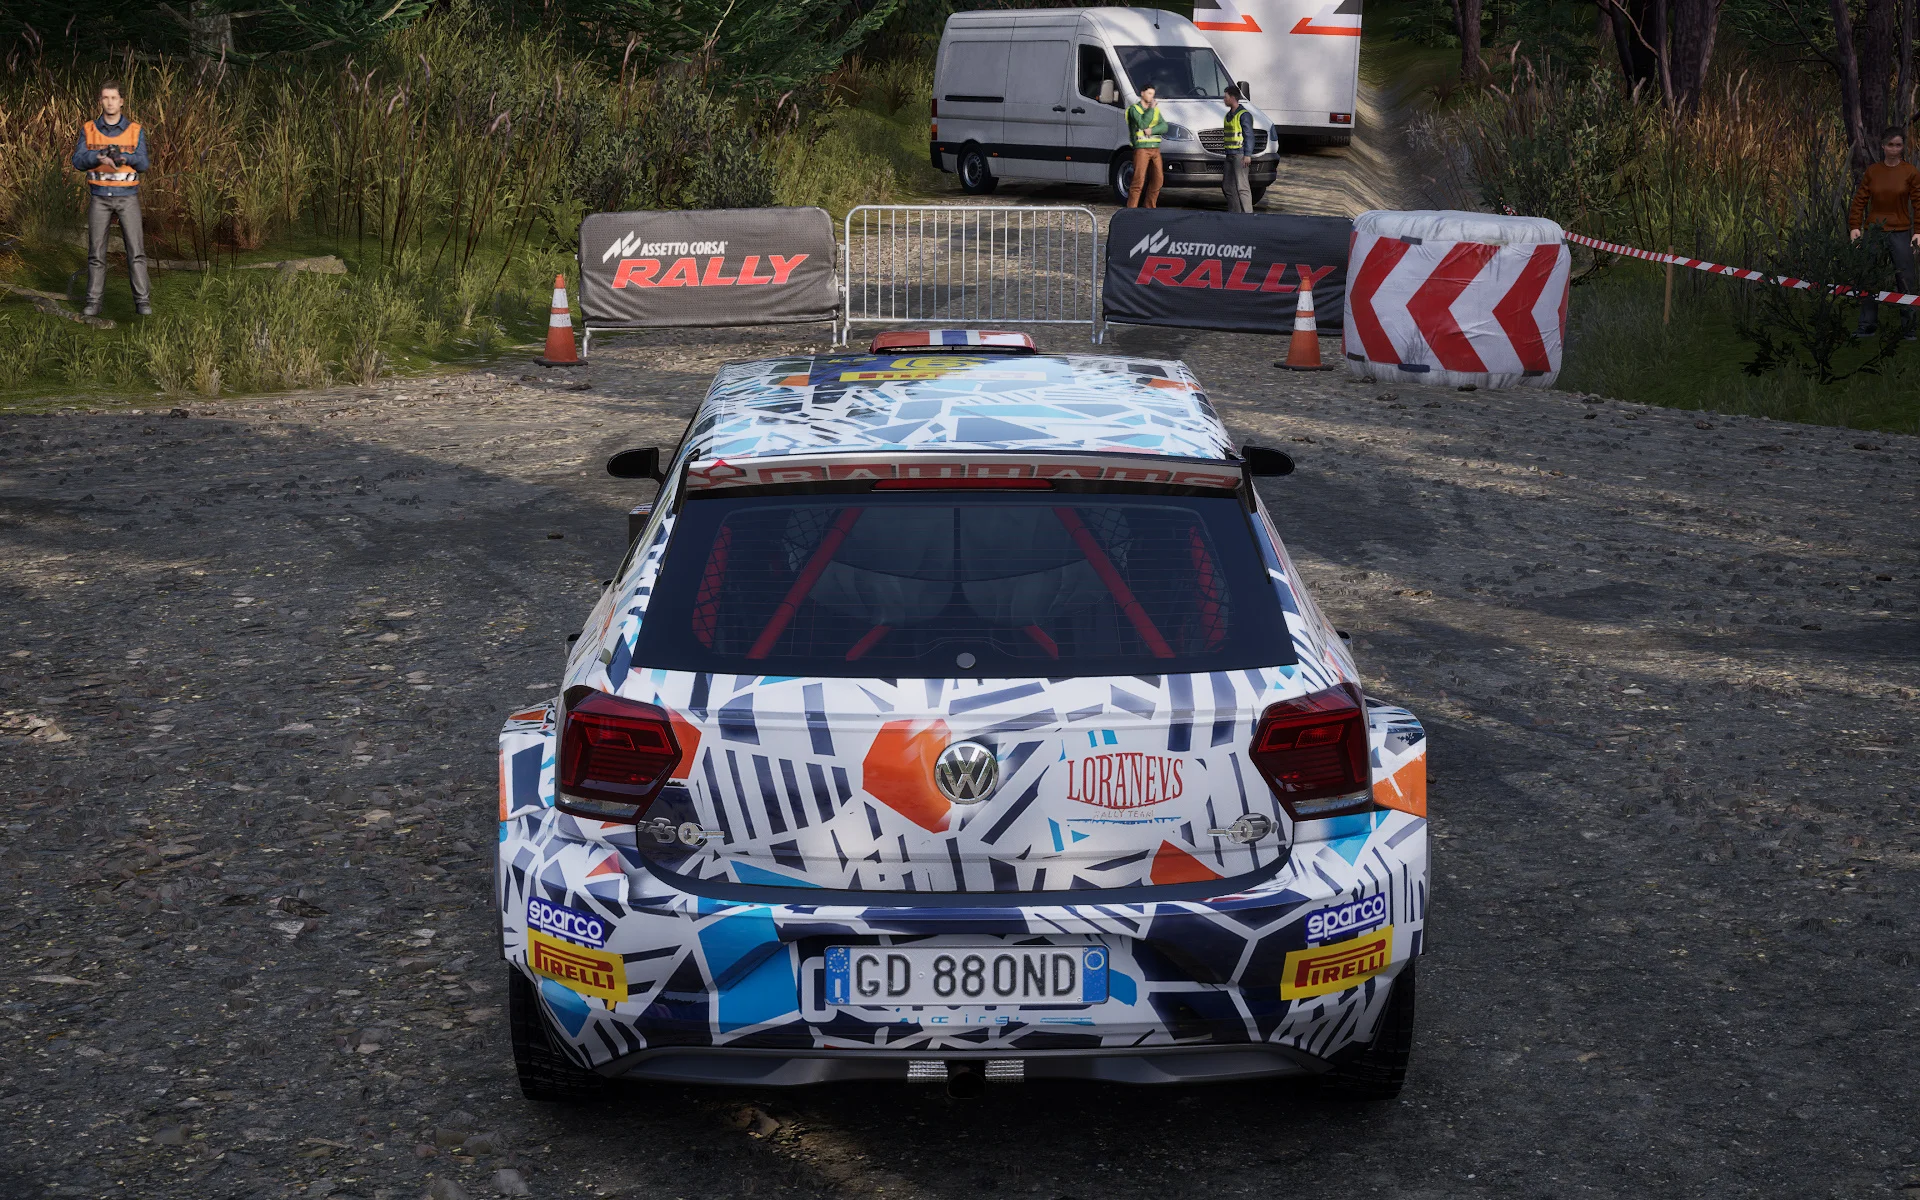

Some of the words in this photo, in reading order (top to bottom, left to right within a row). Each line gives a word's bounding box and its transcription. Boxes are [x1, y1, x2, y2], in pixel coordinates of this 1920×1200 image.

[640, 241, 689, 257] ASSETTO
[689, 241, 726, 255] CORSA
[1167, 241, 1217, 257] ASSETTO
[1217, 244, 1253, 259] CORSA
[611, 254, 809, 289] RALLY
[1067, 753, 1183, 809] LORANEVS
[528, 900, 603, 940] sparco
[1307, 896, 1385, 938] sparco
[534, 940, 615, 990] PIRELLI
[856, 953, 911, 998] GD
[1294, 939, 1386, 988] PIRELLI
